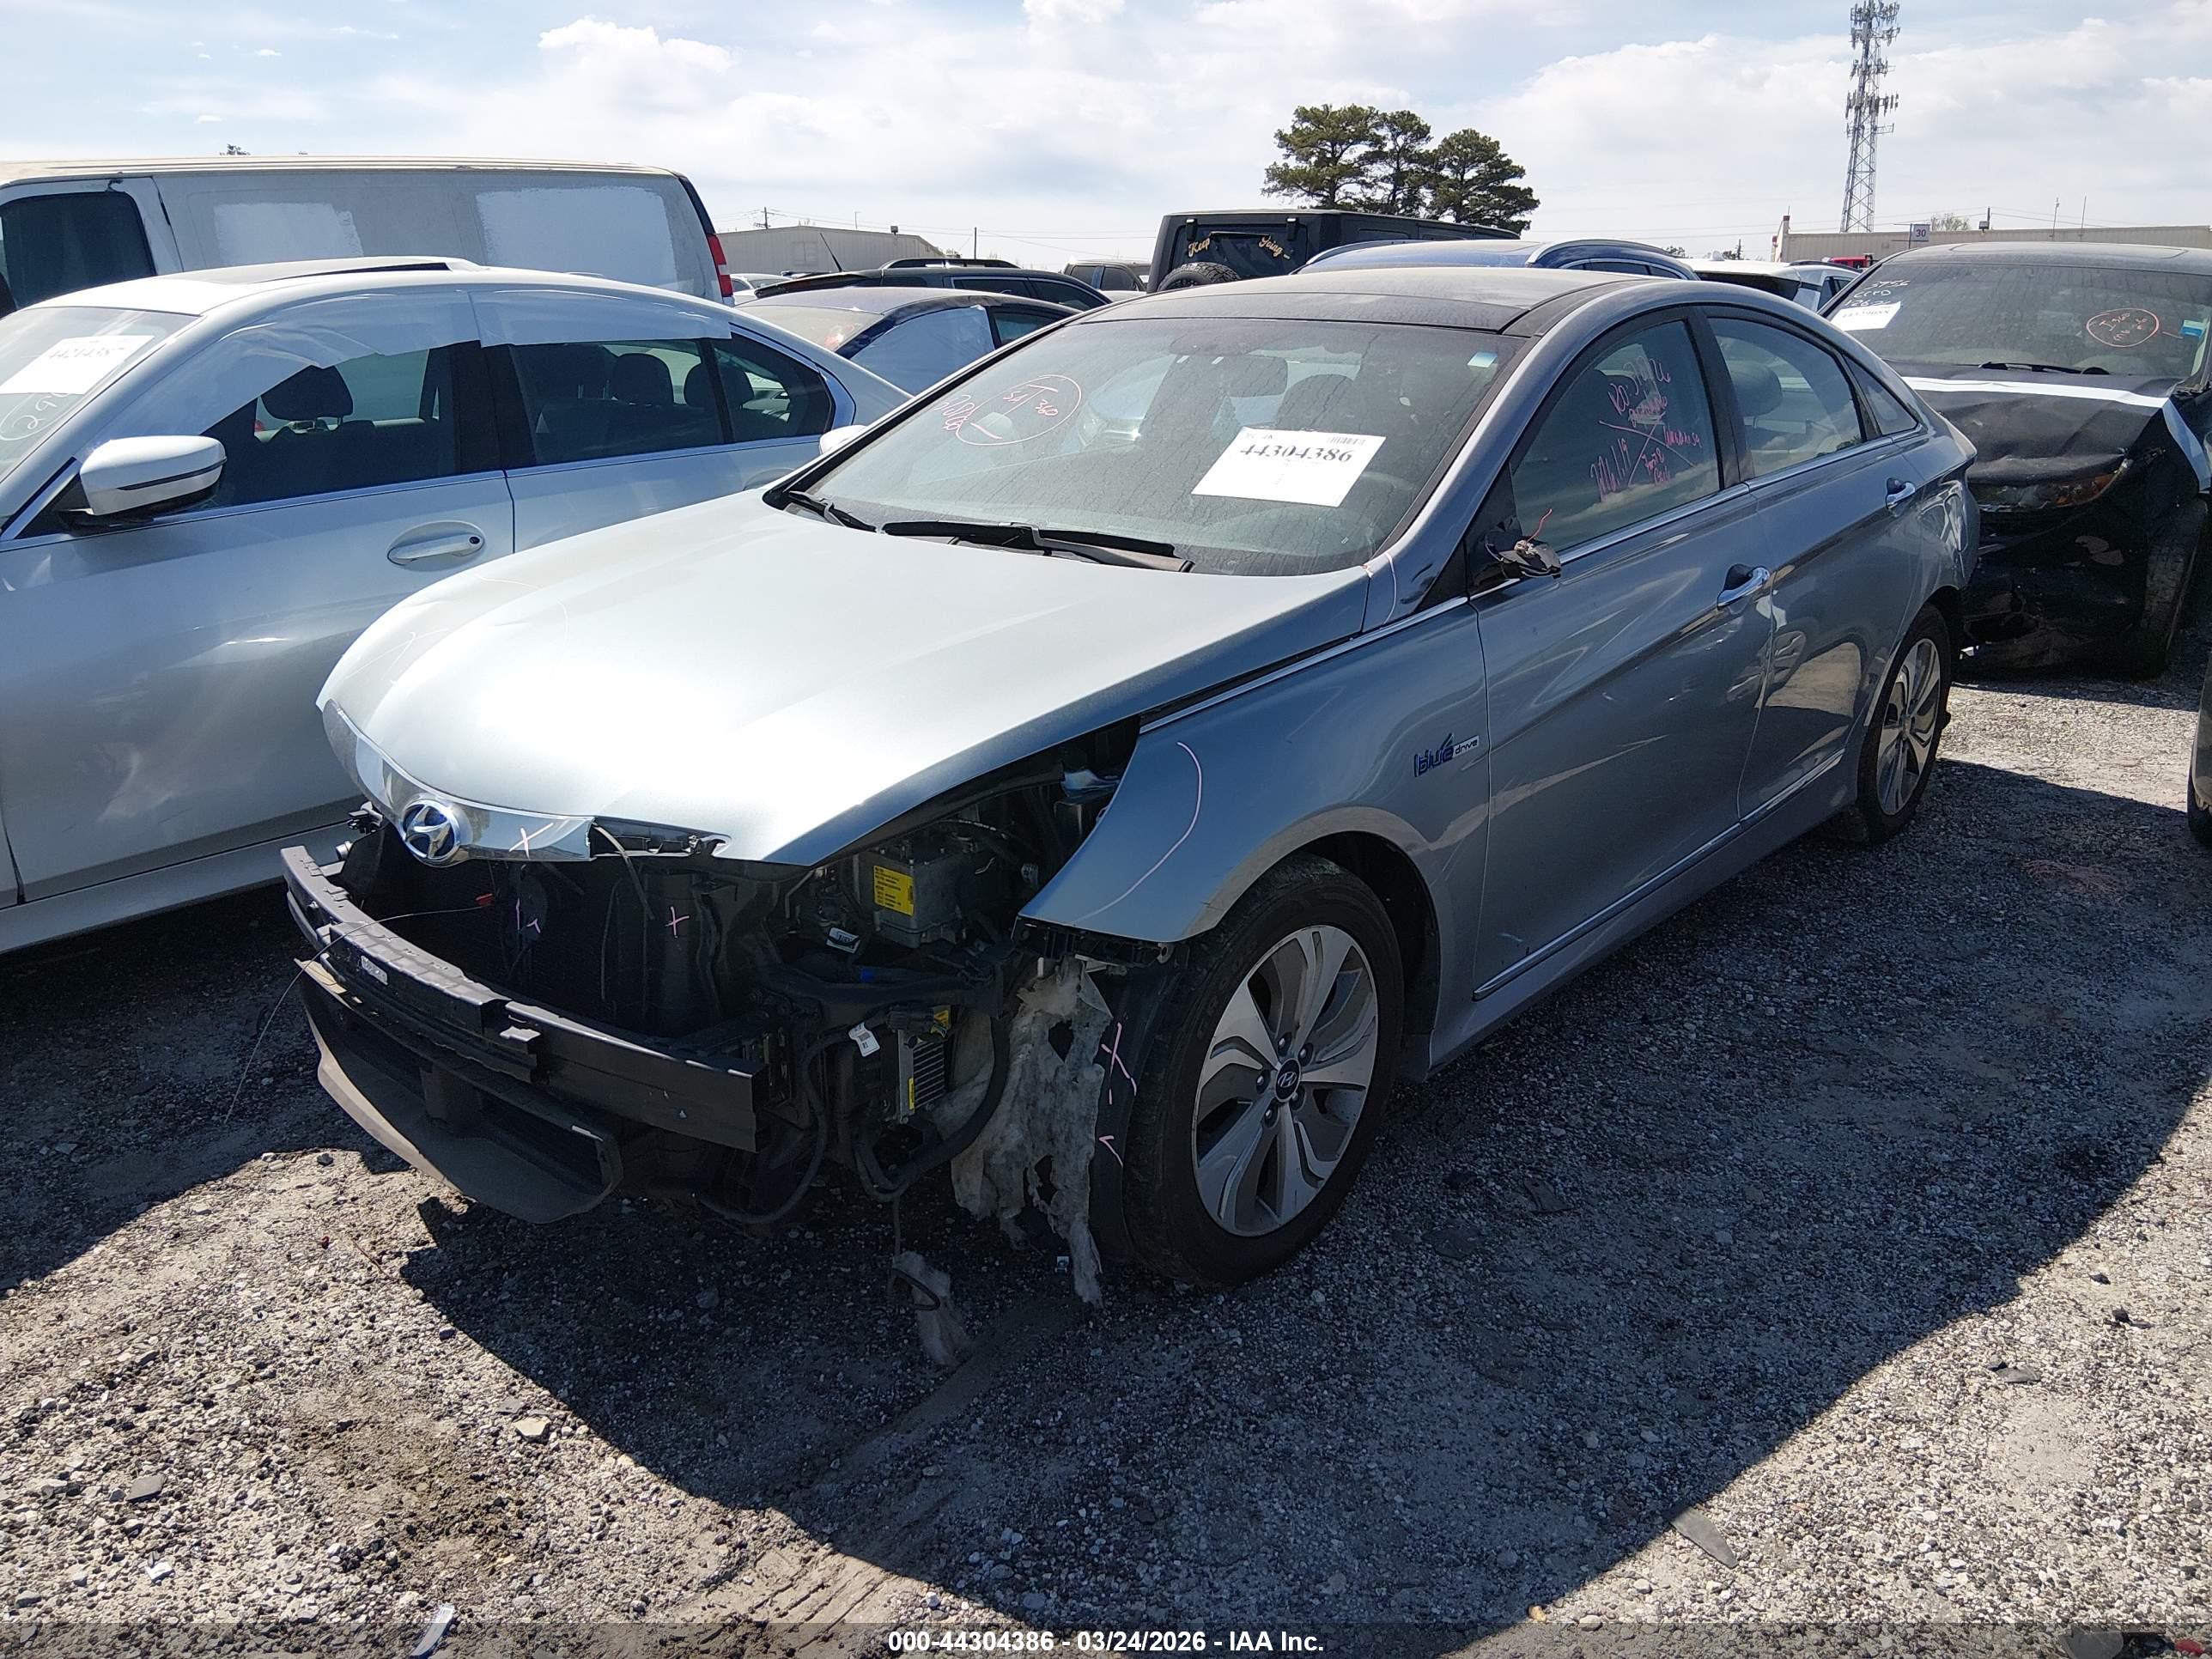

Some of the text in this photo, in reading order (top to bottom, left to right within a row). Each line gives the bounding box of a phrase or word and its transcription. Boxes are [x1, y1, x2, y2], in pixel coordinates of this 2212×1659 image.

[1916, 228, 1927, 238] 30
[1188, 238, 1210, 258] Keep
[1240, 443, 1354, 463] 44304386
[1413, 732, 1455, 778] blue
